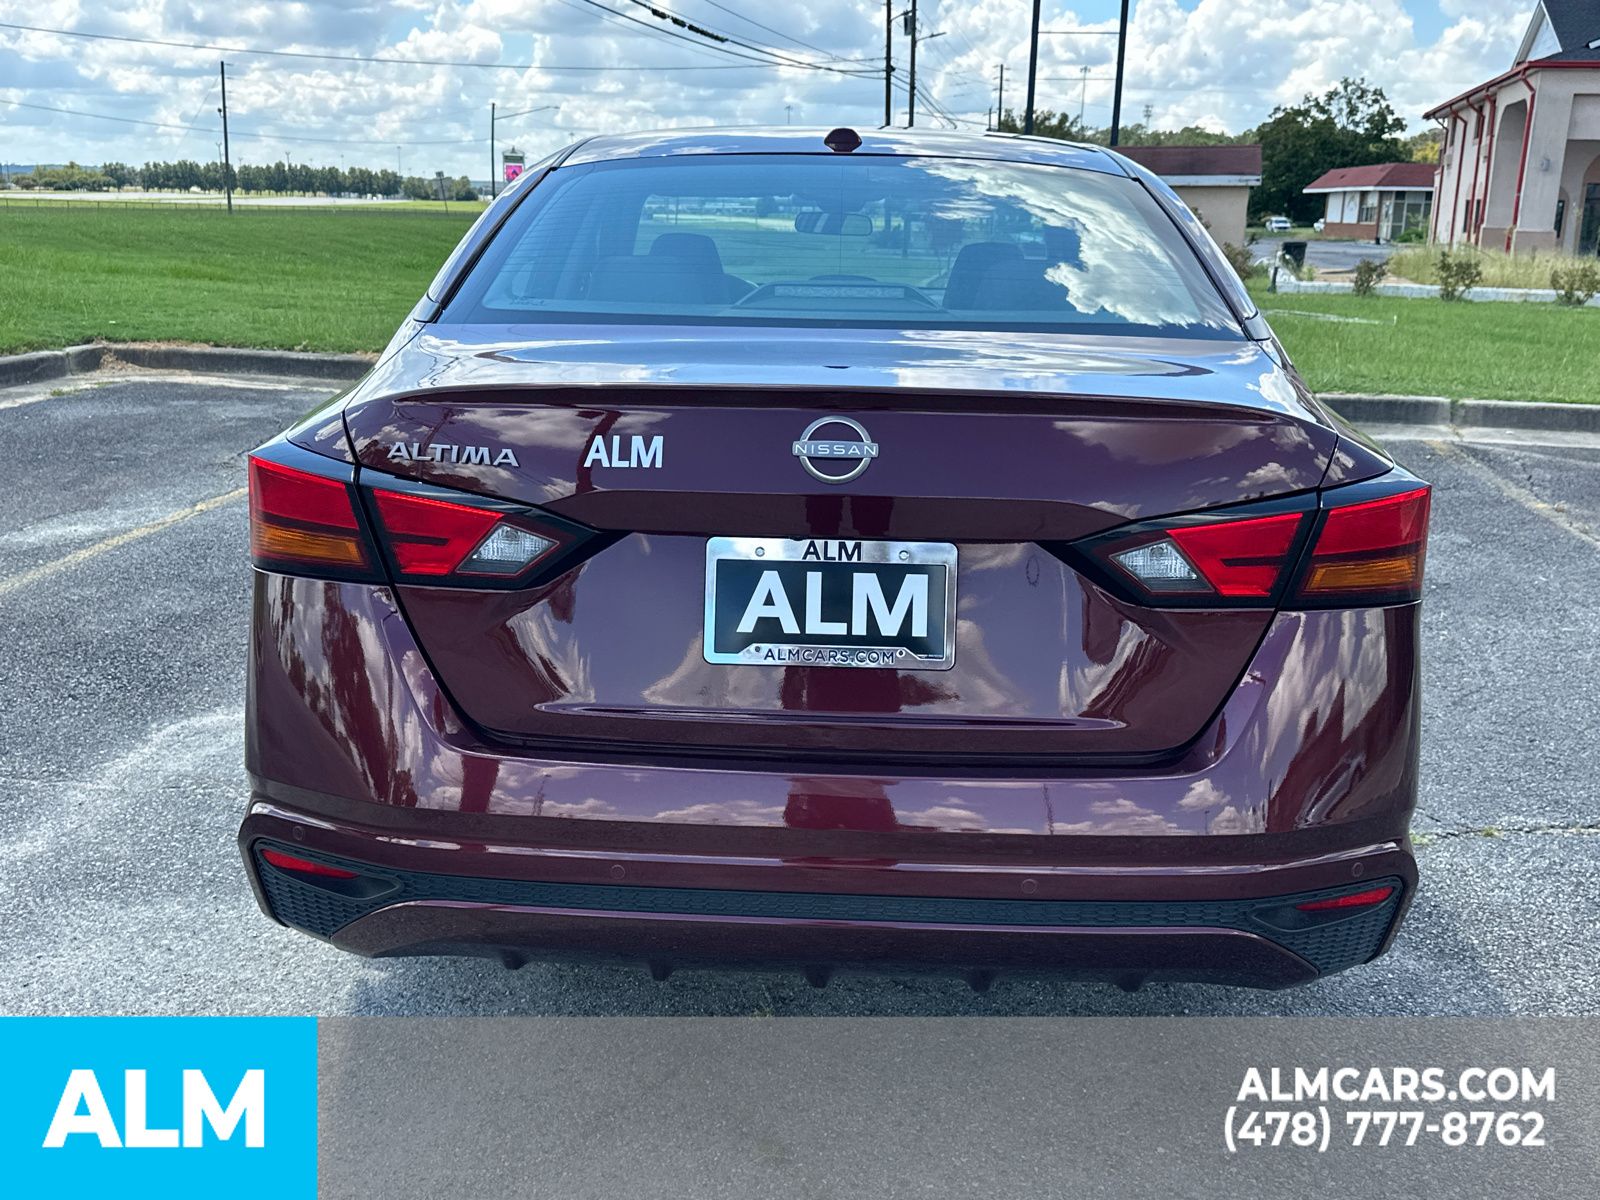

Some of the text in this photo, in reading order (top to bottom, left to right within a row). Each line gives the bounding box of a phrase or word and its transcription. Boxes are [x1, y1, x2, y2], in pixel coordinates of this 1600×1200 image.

[387, 441, 519, 467] ALTIMA
[584, 435, 663, 468] ALM
[795, 443, 876, 456] NISSAN
[802, 540, 862, 562] ALM
[736, 570, 929, 638] ALM
[763, 648, 895, 664] ALMCARS.COM
